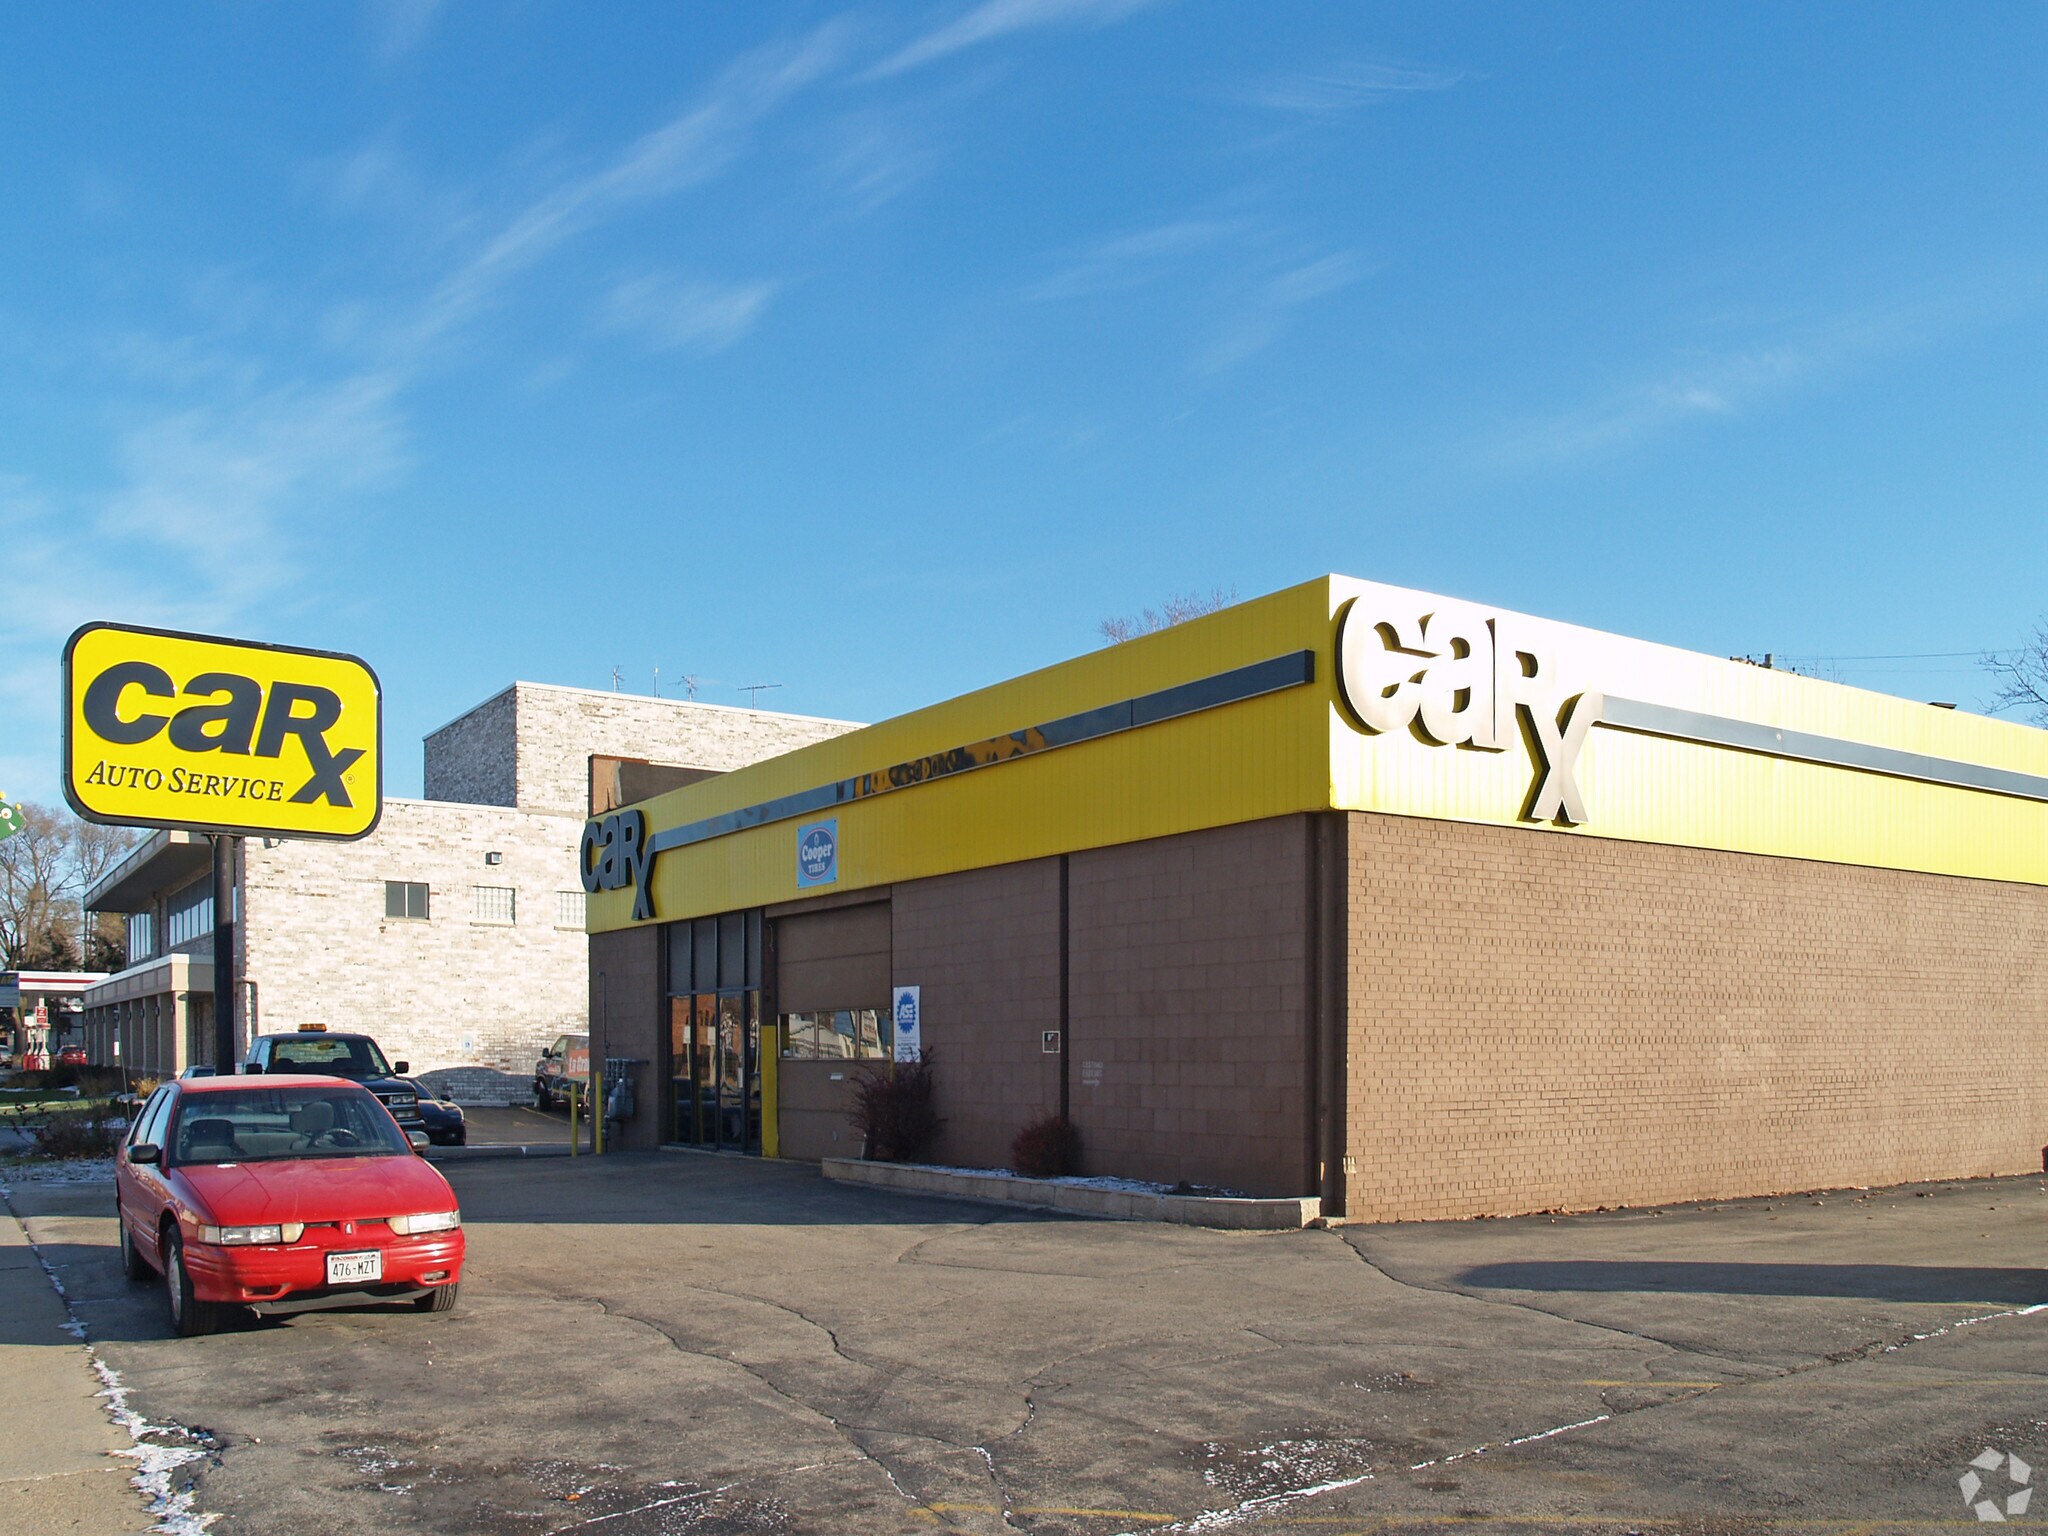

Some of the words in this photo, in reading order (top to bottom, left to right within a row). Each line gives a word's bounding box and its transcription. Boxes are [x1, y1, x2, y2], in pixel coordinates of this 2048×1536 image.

[85, 760, 163, 791] AUTO
[168, 767, 283, 801] SERVICE
[802, 843, 832, 862] Cooper
[808, 862, 826, 874] TIRES
[899, 1003, 914, 1019] ASE
[332, 1260, 375, 1277] 476-MZT
